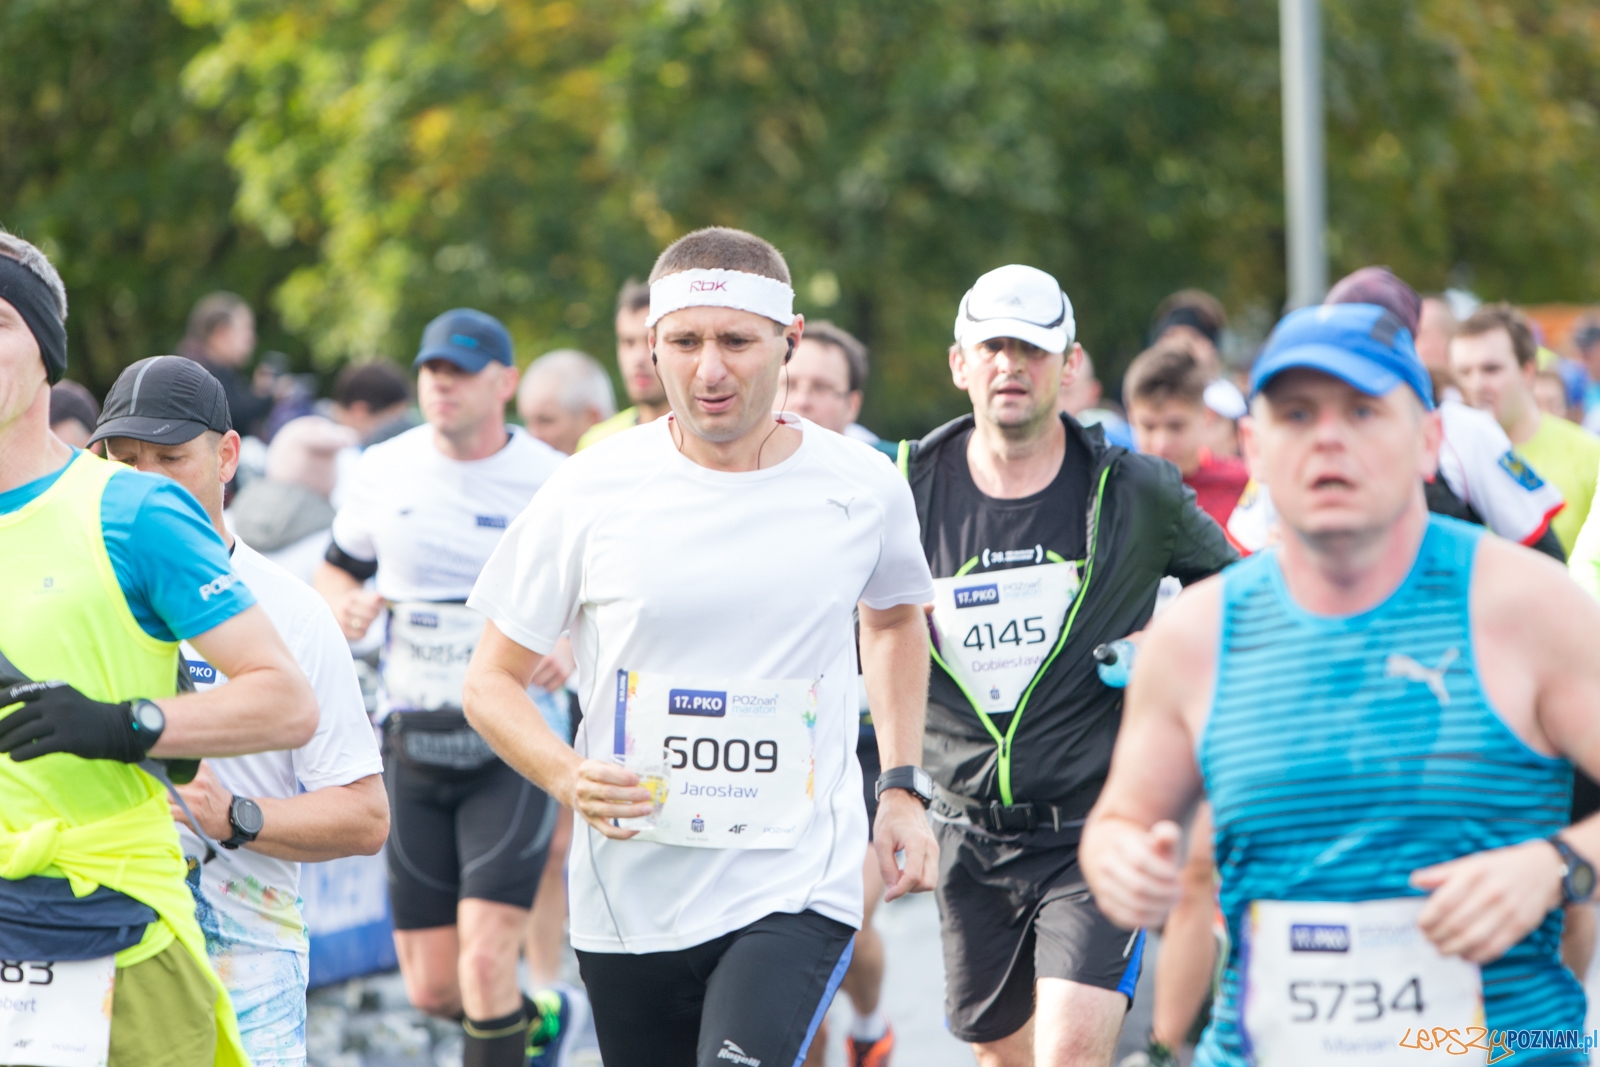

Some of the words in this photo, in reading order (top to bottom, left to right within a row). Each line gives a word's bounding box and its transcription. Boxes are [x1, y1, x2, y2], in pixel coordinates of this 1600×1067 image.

[963, 616, 1046, 651] 4145
[189, 666, 213, 678] PKO
[680, 781, 759, 798] Jarosław
[1289, 976, 1425, 1023] 5734
